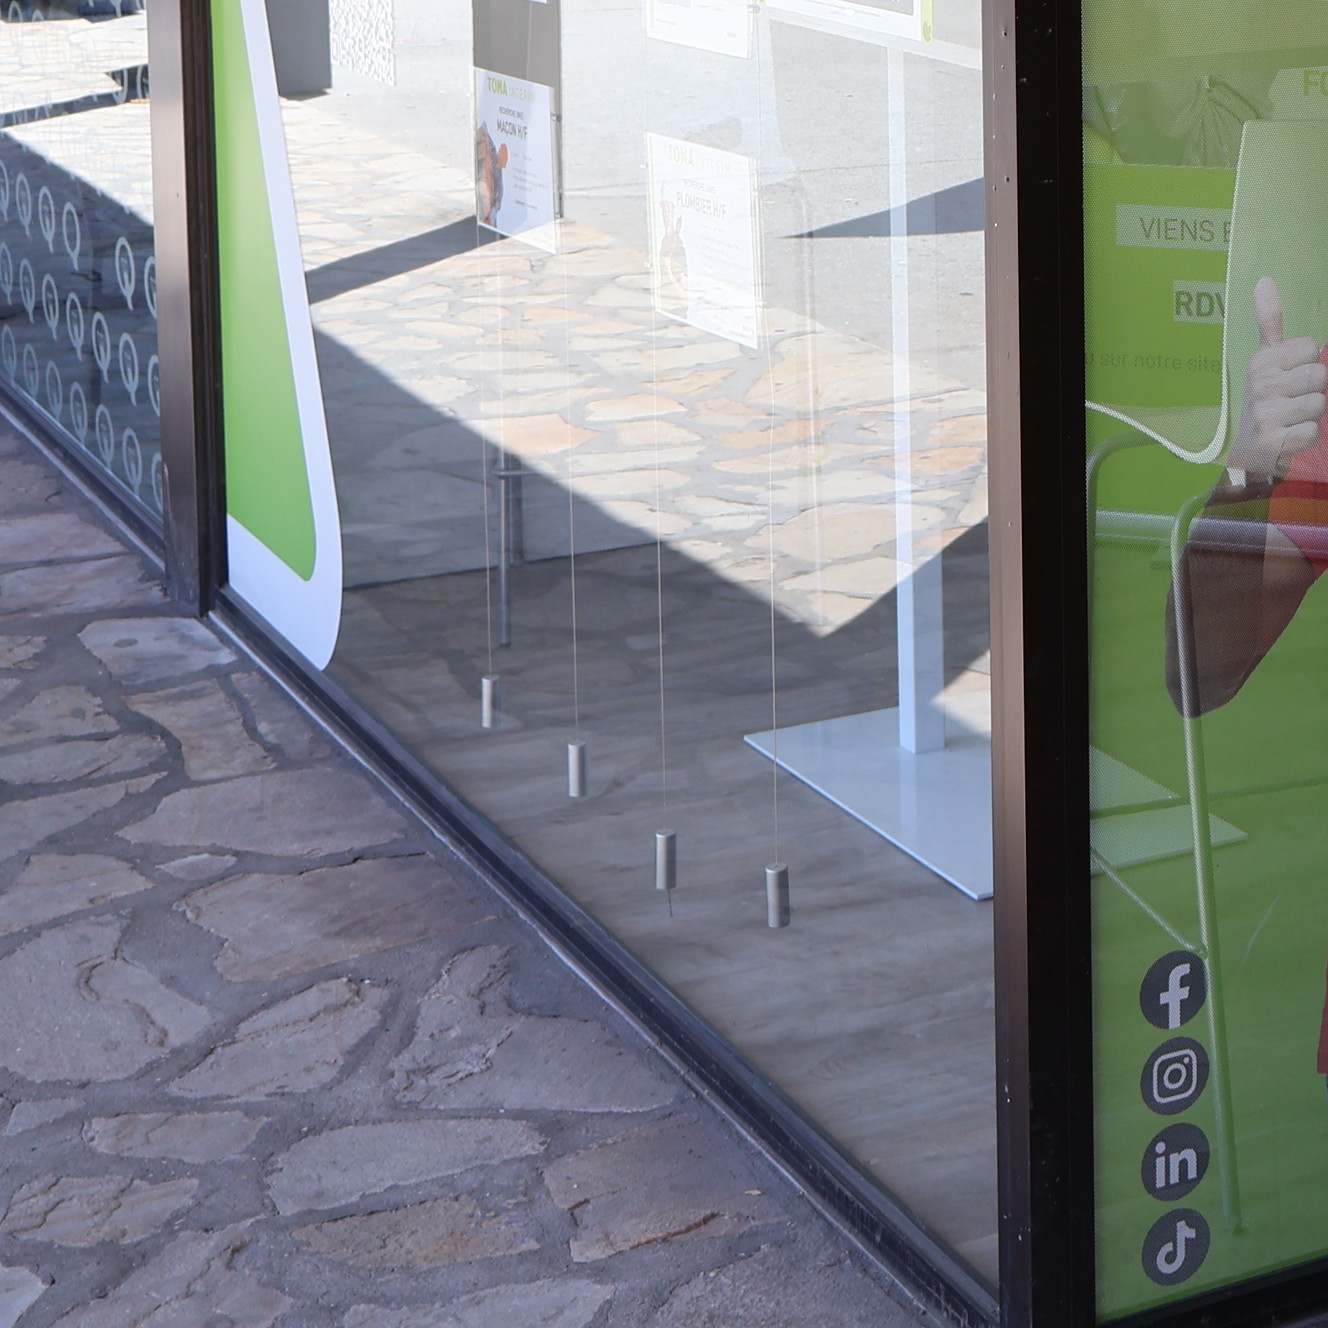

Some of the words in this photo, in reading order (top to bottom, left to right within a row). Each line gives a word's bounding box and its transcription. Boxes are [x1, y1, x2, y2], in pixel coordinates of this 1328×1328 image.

[487, 77, 508, 96] TOMA
[497, 118, 516, 138] MAÇON
[668, 144, 694, 167] TOMA
[676, 190, 711, 216] PLOMBIER
[1139, 217, 1215, 243] VIENS
